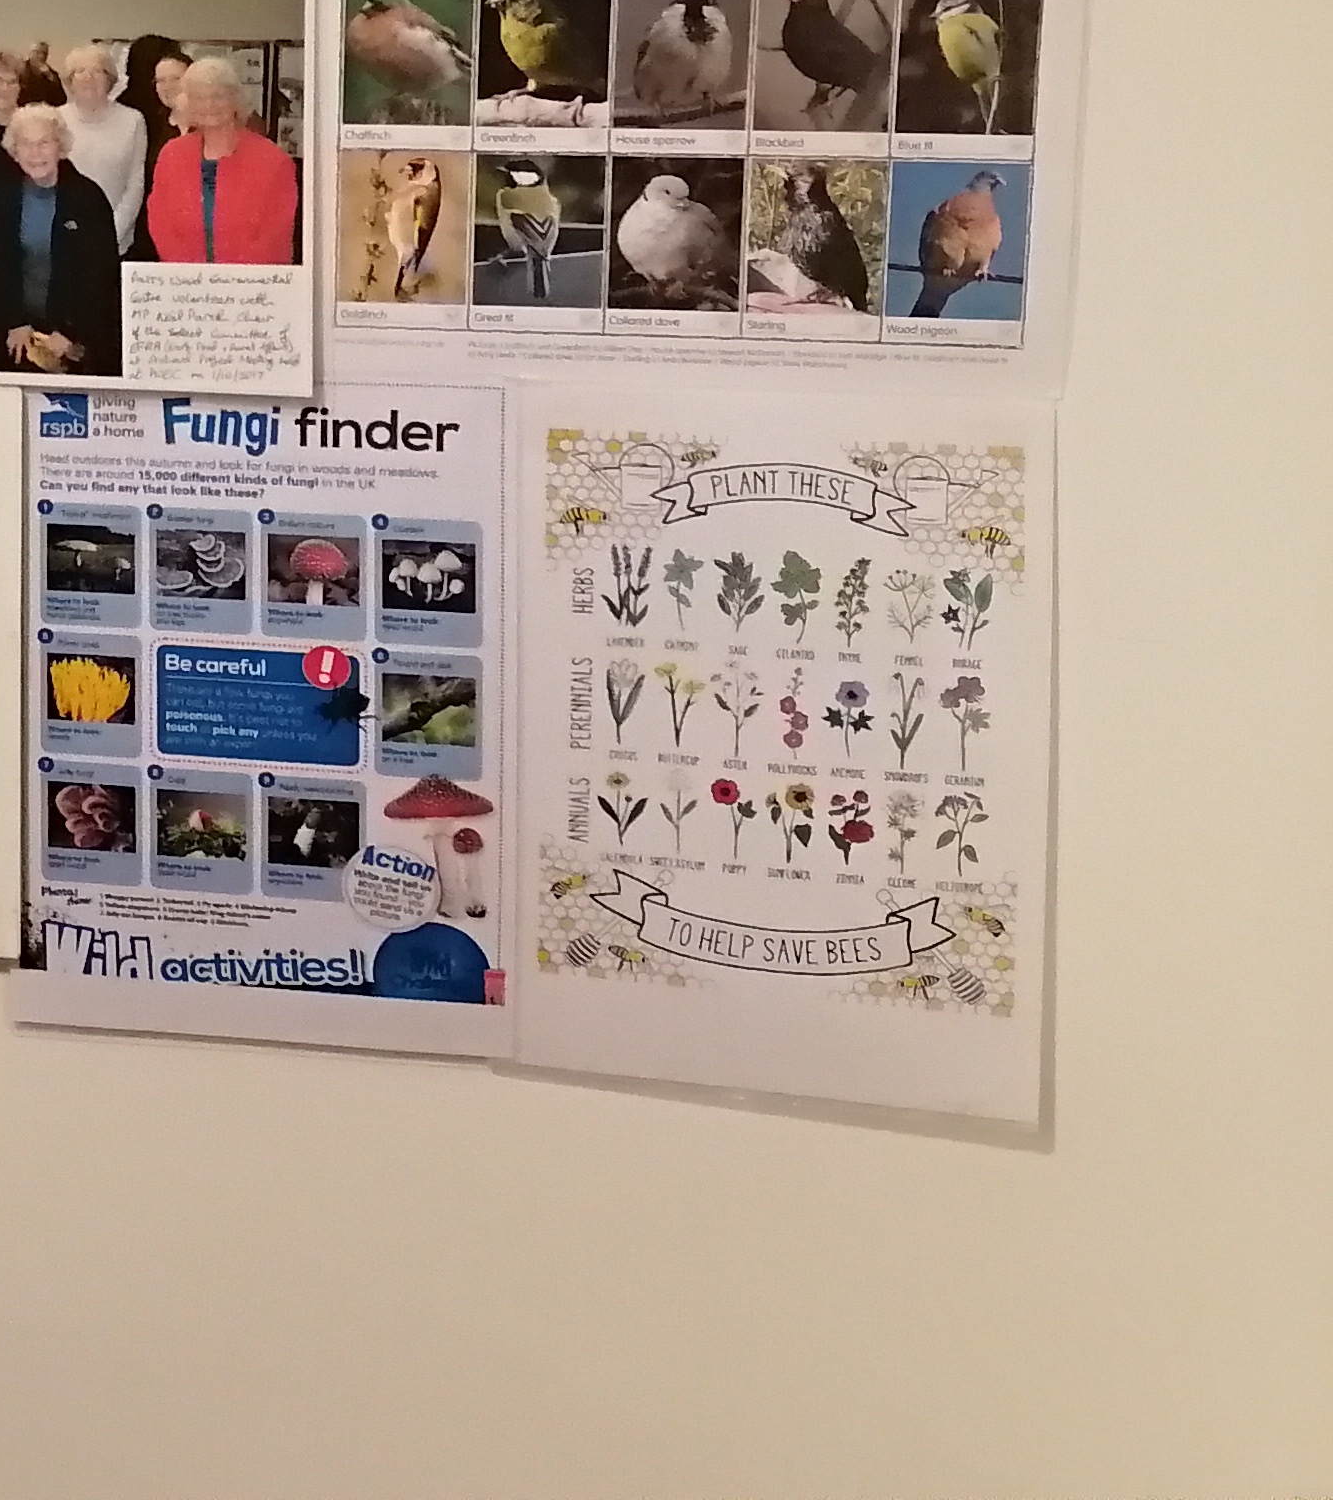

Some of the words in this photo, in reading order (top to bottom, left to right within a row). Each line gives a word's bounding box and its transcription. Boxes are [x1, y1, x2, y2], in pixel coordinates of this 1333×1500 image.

[42, 418, 86, 437] rspb
[162, 397, 281, 457] Fungi
[294, 405, 460, 453] finder
[710, 470, 779, 498] PLANT
[788, 471, 855, 505] THESE
[573, 566, 595, 615] HERBS
[164, 653, 193, 671] Be
[196, 657, 267, 677] careful
[570, 657, 593, 750] PERENNIALS
[567, 776, 590, 844] ANNUALS
[362, 845, 436, 883] Action
[668, 917, 692, 947] TO
[698, 926, 754, 959] HELP
[763, 938, 818, 965] SAVE
[826, 936, 882, 965] BEES
